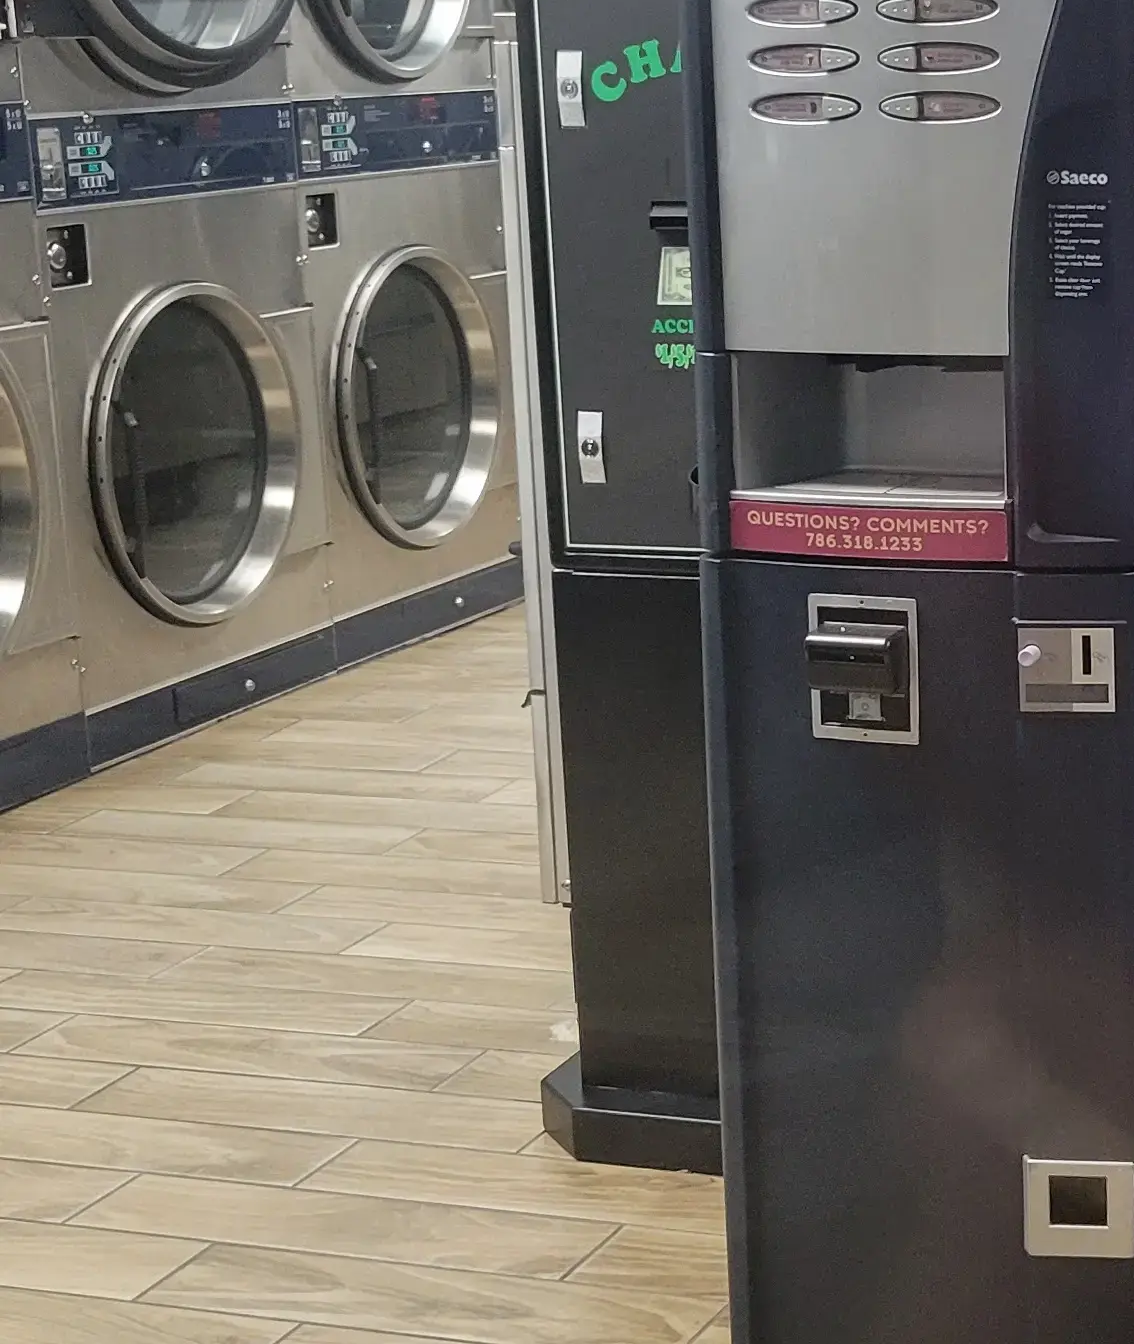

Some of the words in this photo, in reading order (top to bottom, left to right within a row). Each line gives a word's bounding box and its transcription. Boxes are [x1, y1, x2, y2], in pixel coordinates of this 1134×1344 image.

[1061, 170, 1108, 185] Saeco
[747, 510, 860, 531] QUESTIONS?
[867, 517, 989, 535] COMMENTS?
[805, 533, 923, 552] 786.318.1233
